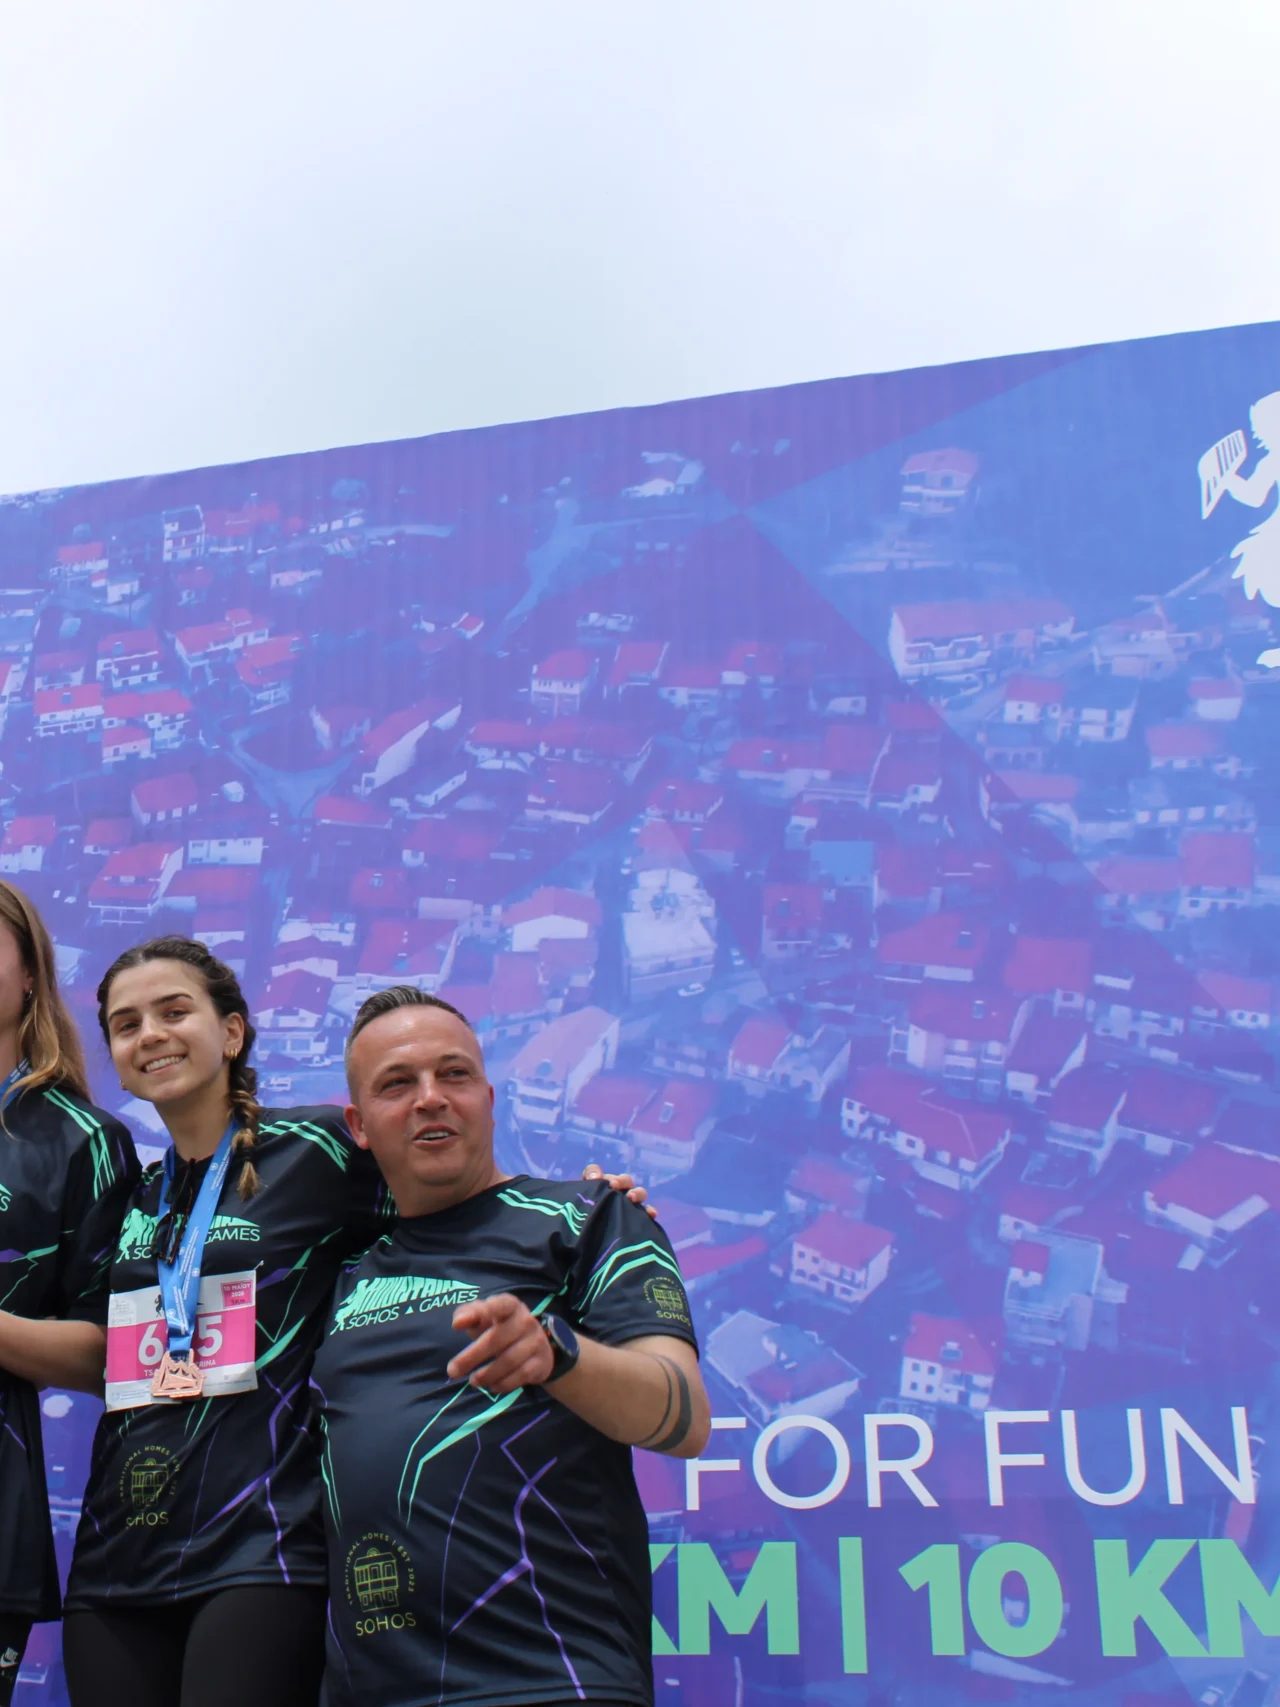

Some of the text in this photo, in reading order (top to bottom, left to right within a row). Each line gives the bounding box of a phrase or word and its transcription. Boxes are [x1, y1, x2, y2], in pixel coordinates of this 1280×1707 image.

[345, 1289, 480, 1331] SOHOS GAMES
[138, 1315, 223, 1367] 65
[685, 1406, 1257, 1511] FOR FUN
[355, 1612, 417, 1636] SOHOS
[649, 1541, 800, 1656] M
[897, 1542, 1064, 1658] 10
